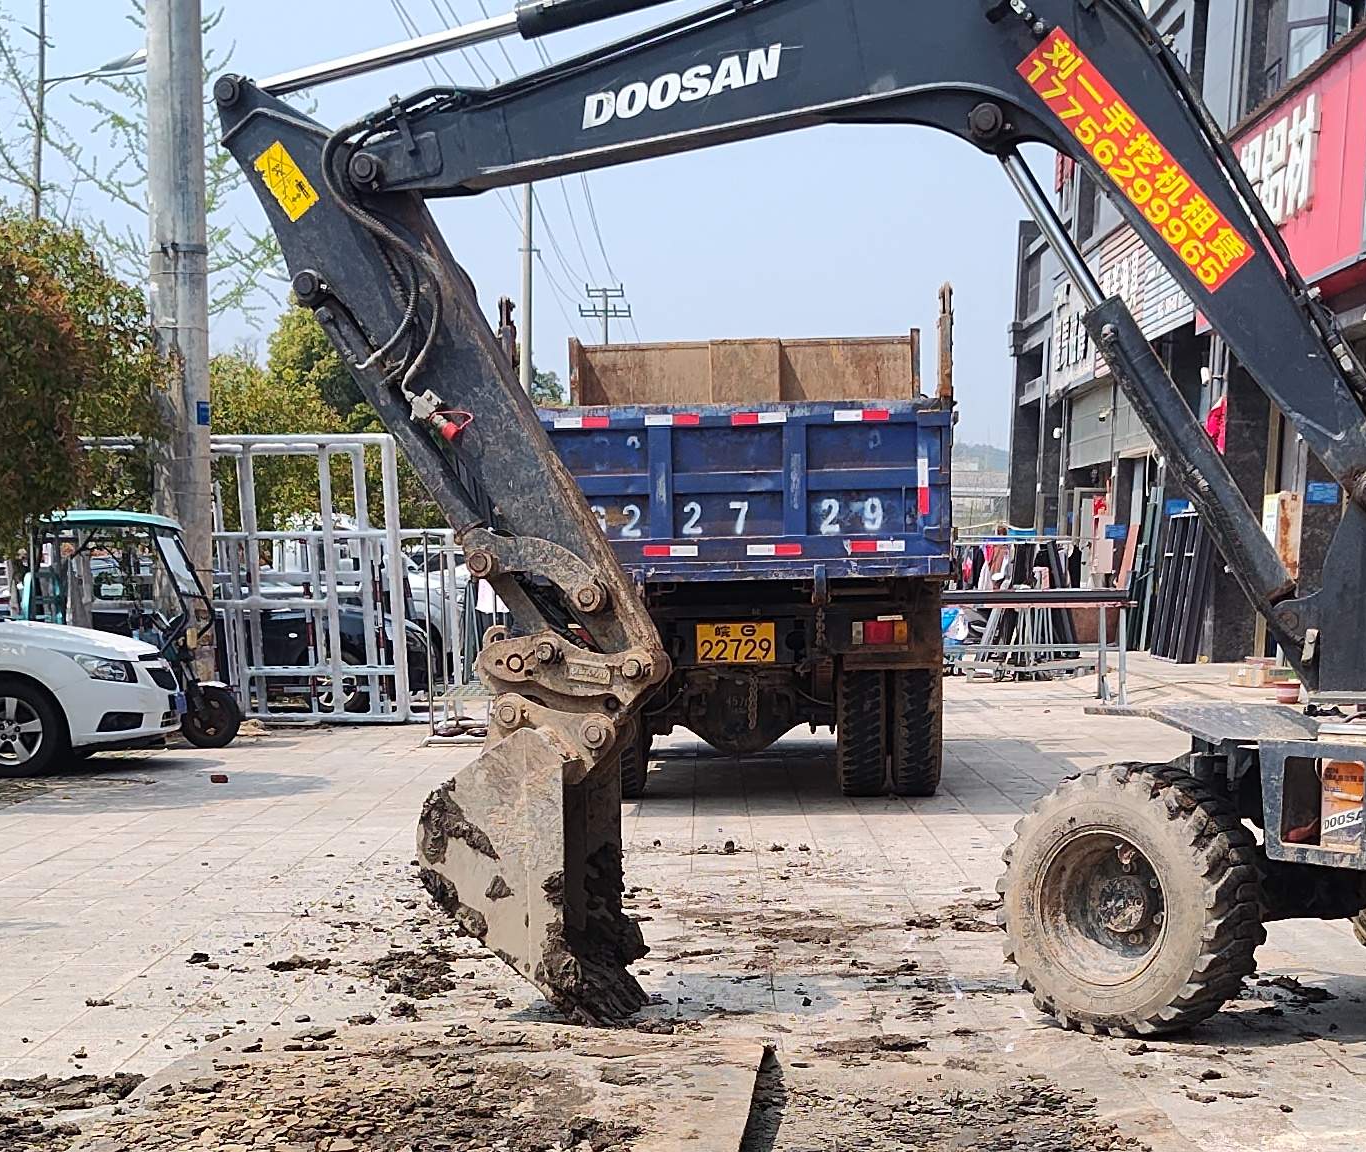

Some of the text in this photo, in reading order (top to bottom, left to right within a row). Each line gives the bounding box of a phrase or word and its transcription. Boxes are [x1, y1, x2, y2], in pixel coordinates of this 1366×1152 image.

[582, 43, 782, 129] DOOSAN
[1043, 38, 1246, 268] 刘一手挖机租赁
[1026, 59, 1218, 285] 17756299965
[700, 638, 772, 661] 22729
